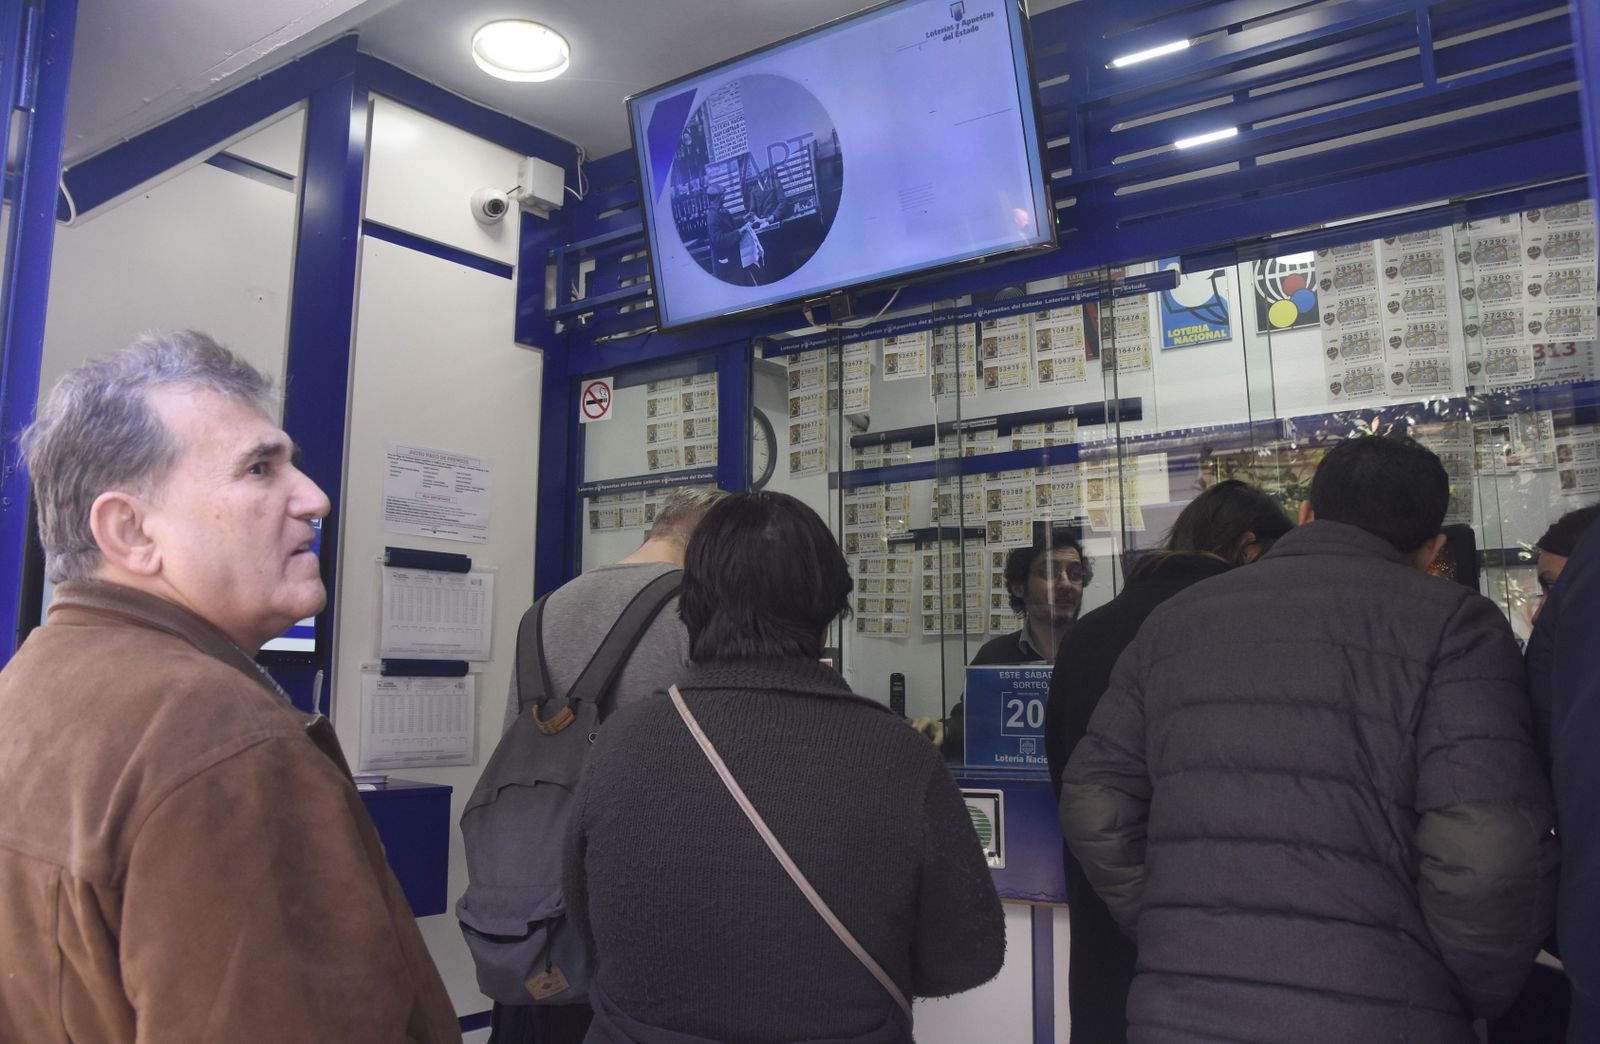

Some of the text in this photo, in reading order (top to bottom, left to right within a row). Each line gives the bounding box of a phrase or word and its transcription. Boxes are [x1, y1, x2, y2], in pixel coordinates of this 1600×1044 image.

[961, 10, 994, 27] Apuestas
[942, 24, 980, 42] del Estado
[1022, 300, 1042, 308] Estado
[1168, 324, 1210, 338] LOTERIA
[1173, 328, 1228, 345] NACIONAL
[999, 671, 1021, 680] ESTE
[1012, 680, 1048, 689] SORTEO
[1006, 699, 1044, 729] 20
